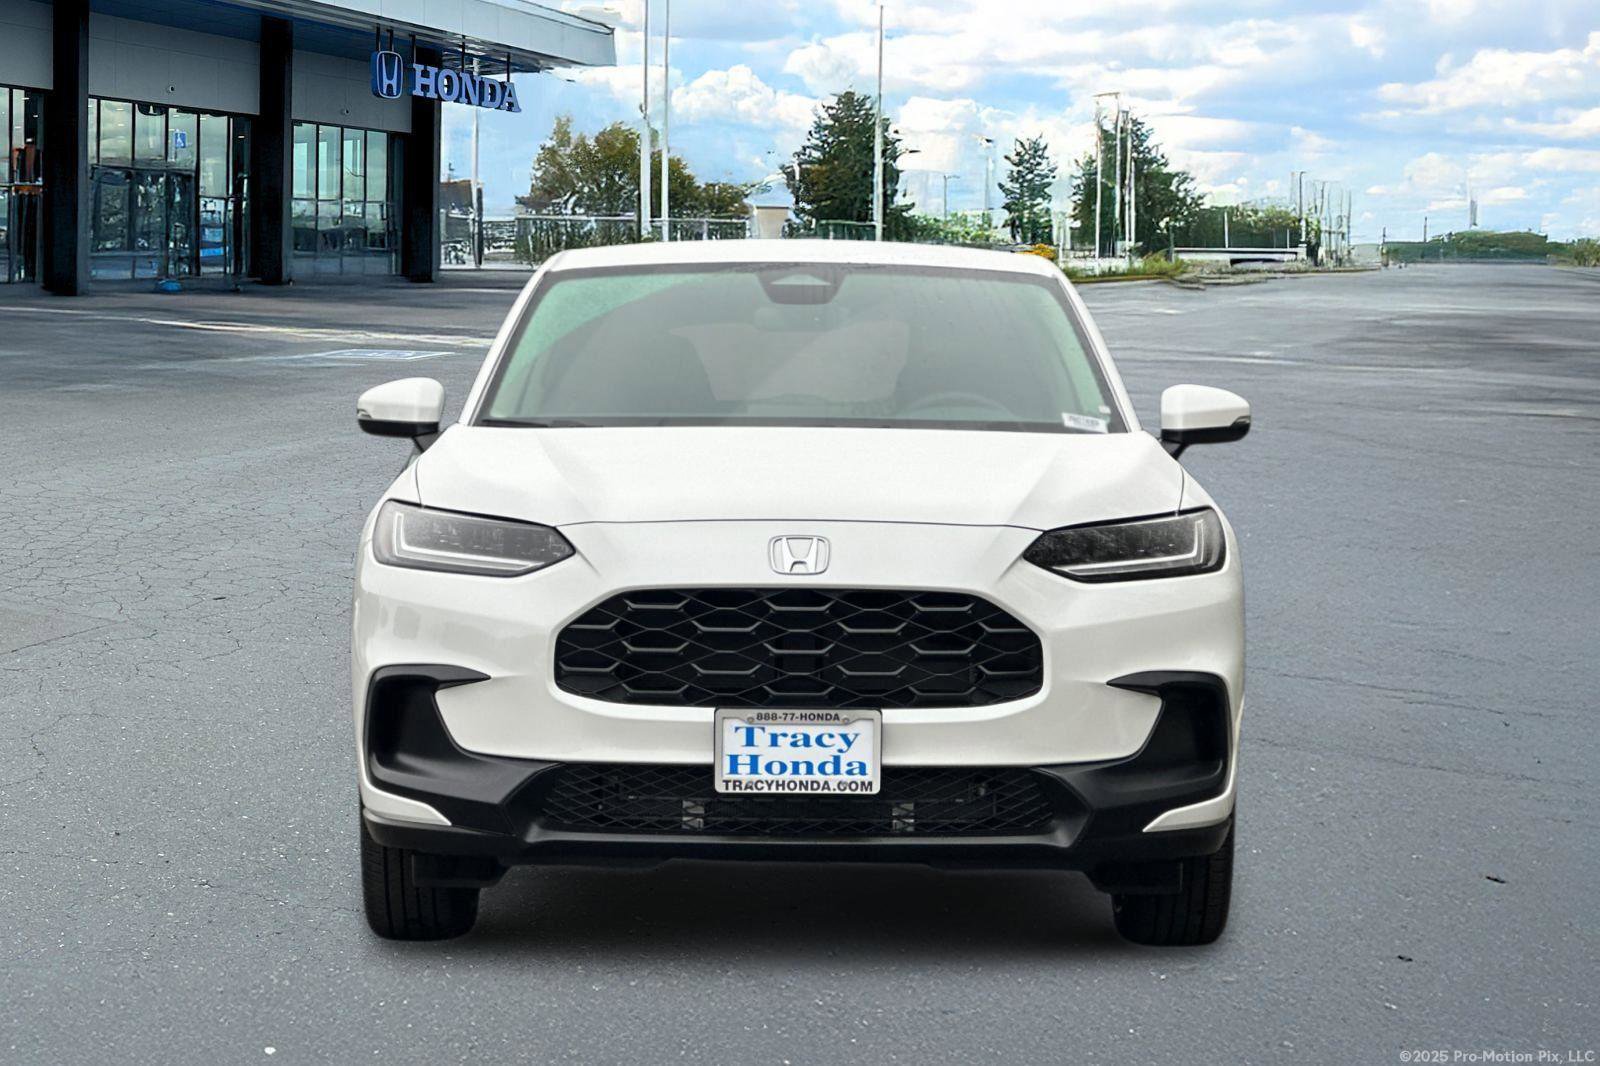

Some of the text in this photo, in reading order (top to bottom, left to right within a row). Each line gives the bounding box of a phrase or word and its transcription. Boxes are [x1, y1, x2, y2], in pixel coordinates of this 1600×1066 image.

[412, 63, 521, 112] HONDA
[756, 712, 840, 722] 888-77-HONDA
[734, 726, 861, 753] Tracy
[726, 754, 868, 776] Honda
[722, 779, 873, 792] TRACYHONDA.COM
